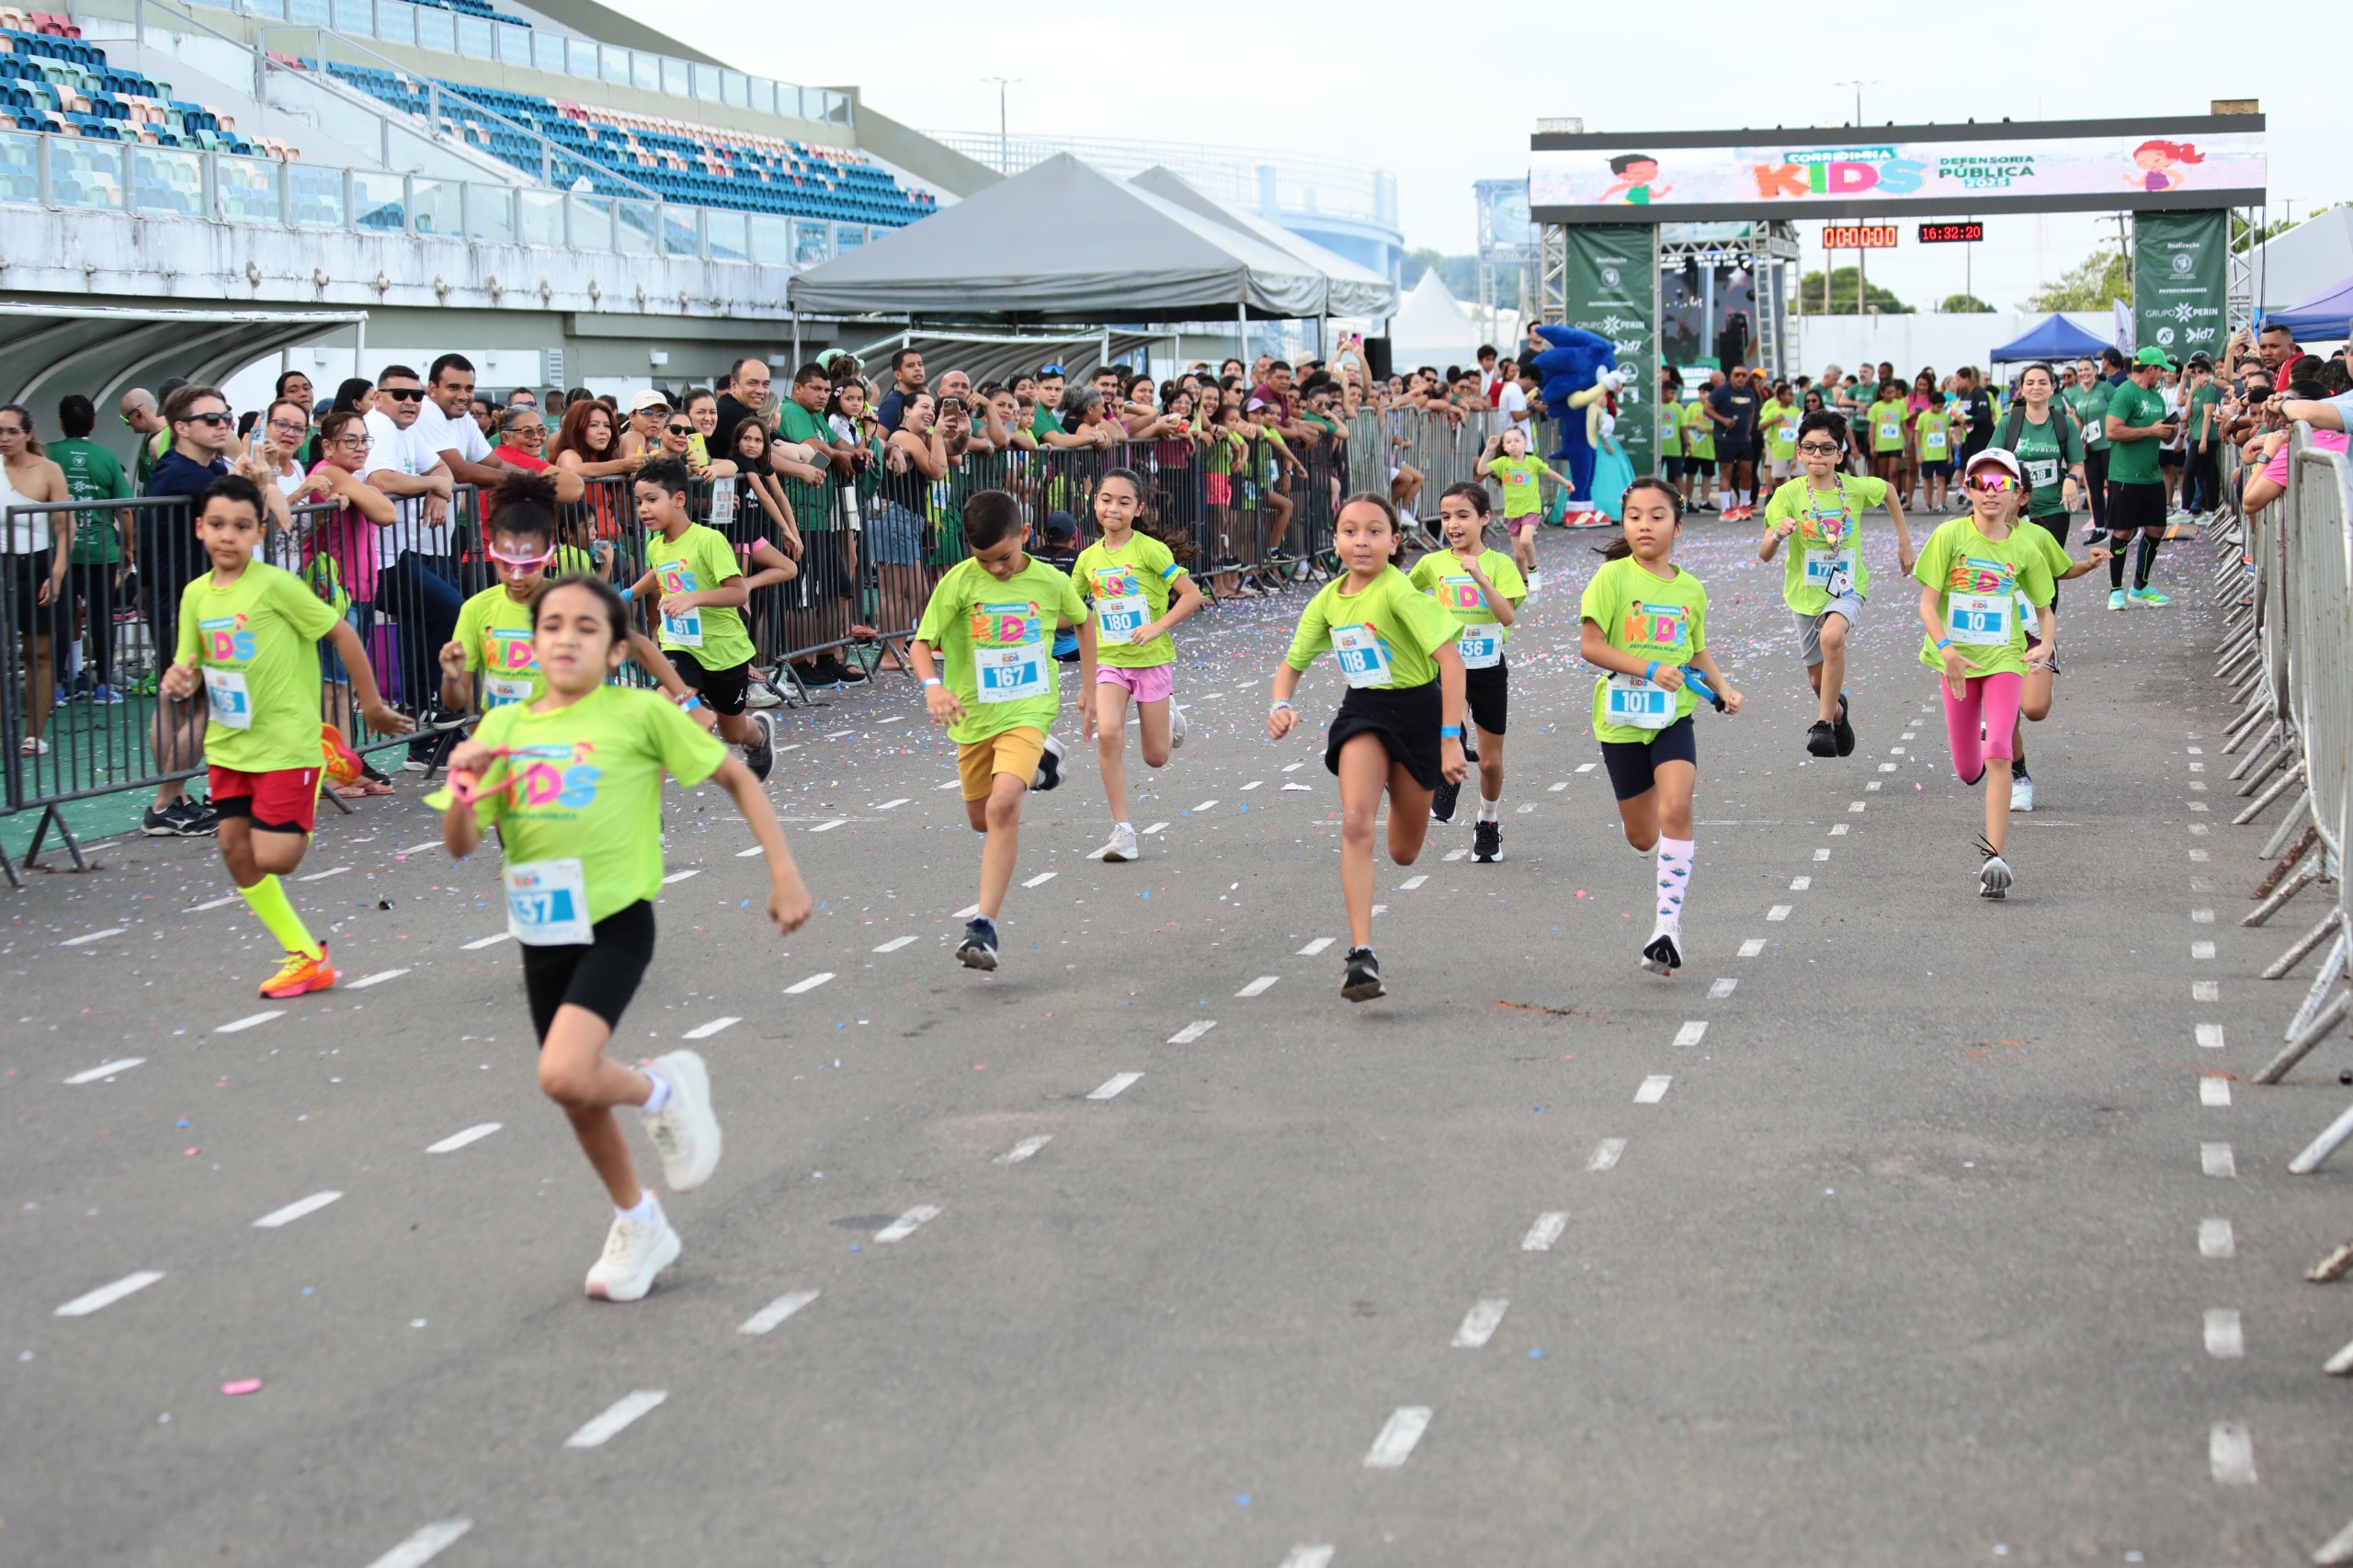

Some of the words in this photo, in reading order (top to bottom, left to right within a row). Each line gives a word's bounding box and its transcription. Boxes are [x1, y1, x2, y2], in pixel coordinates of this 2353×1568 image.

[1788, 150, 1893, 163] CORRIDINHA
[1940, 156, 2034, 165] DEFENSORIA
[1753, 159, 1927, 198] KIDS
[1938, 164, 2034, 178] PÚBLICA
[1967, 177, 2006, 187] 2025
[1923, 225, 1981, 241] 16:32:20
[2146, 309, 2176, 317] GRUPO
[2193, 308, 2218, 316] PERIN
[1089, 575, 1139, 599] KIDS
[1949, 566, 2015, 596] KIDS
[673, 620, 689, 634] 191
[972, 614, 1040, 642] KIDS
[1107, 614, 1131, 631] 180
[1624, 615, 1688, 646] KIDS
[1968, 613, 1985, 631] 10
[200, 631, 256, 661] IDS
[1459, 640, 1484, 656] 136
[1342, 651, 1366, 672] 118
[994, 665, 1025, 687] 167
[1622, 691, 1650, 712] 101
